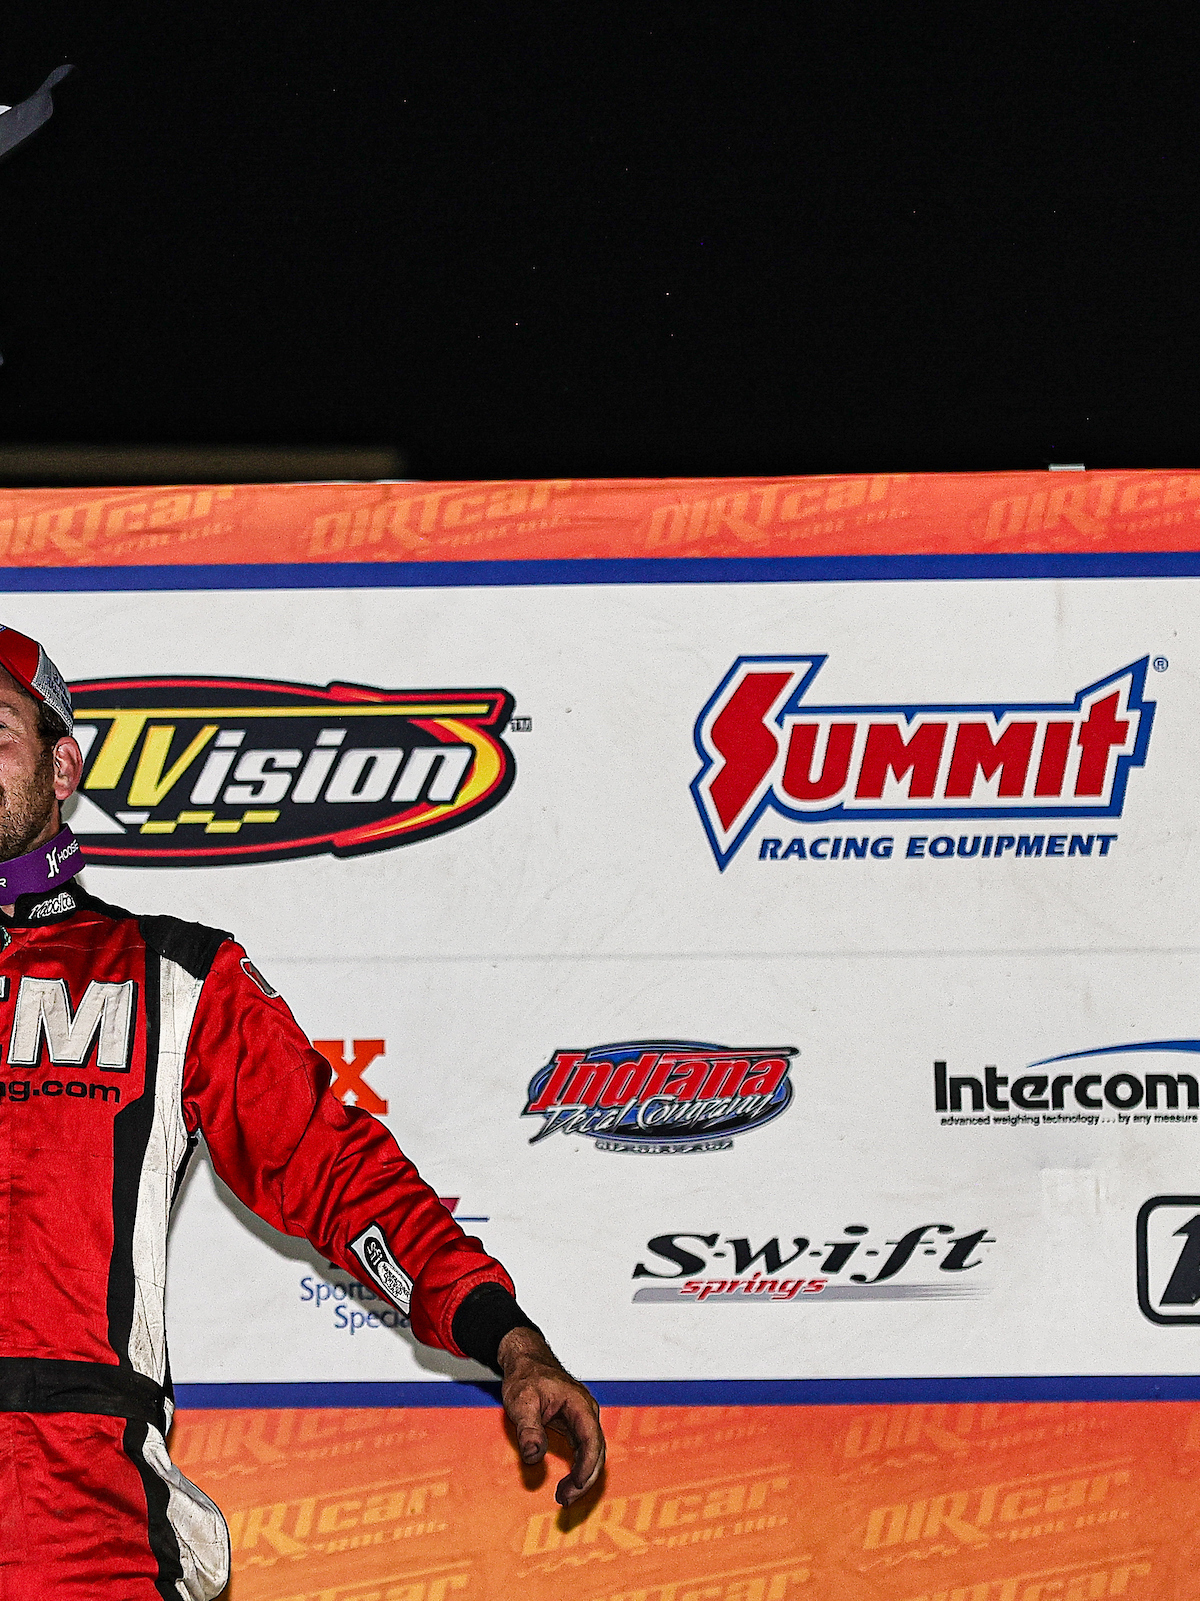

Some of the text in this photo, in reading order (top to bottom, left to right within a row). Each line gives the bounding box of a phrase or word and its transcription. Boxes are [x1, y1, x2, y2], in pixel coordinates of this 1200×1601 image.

[758, 833, 1119, 861] RACING EQUIPMENT
[528, 1050, 790, 1112] Indiana
[637, 1094, 774, 1129] Company
[941, 1115, 990, 1126] advanced
[993, 1115, 1040, 1127] weighing
[1042, 1115, 1100, 1127] technology
[1118, 1114, 1130, 1126] by
[1133, 1116, 1151, 1127] any
[680, 1276, 829, 1301] springs
